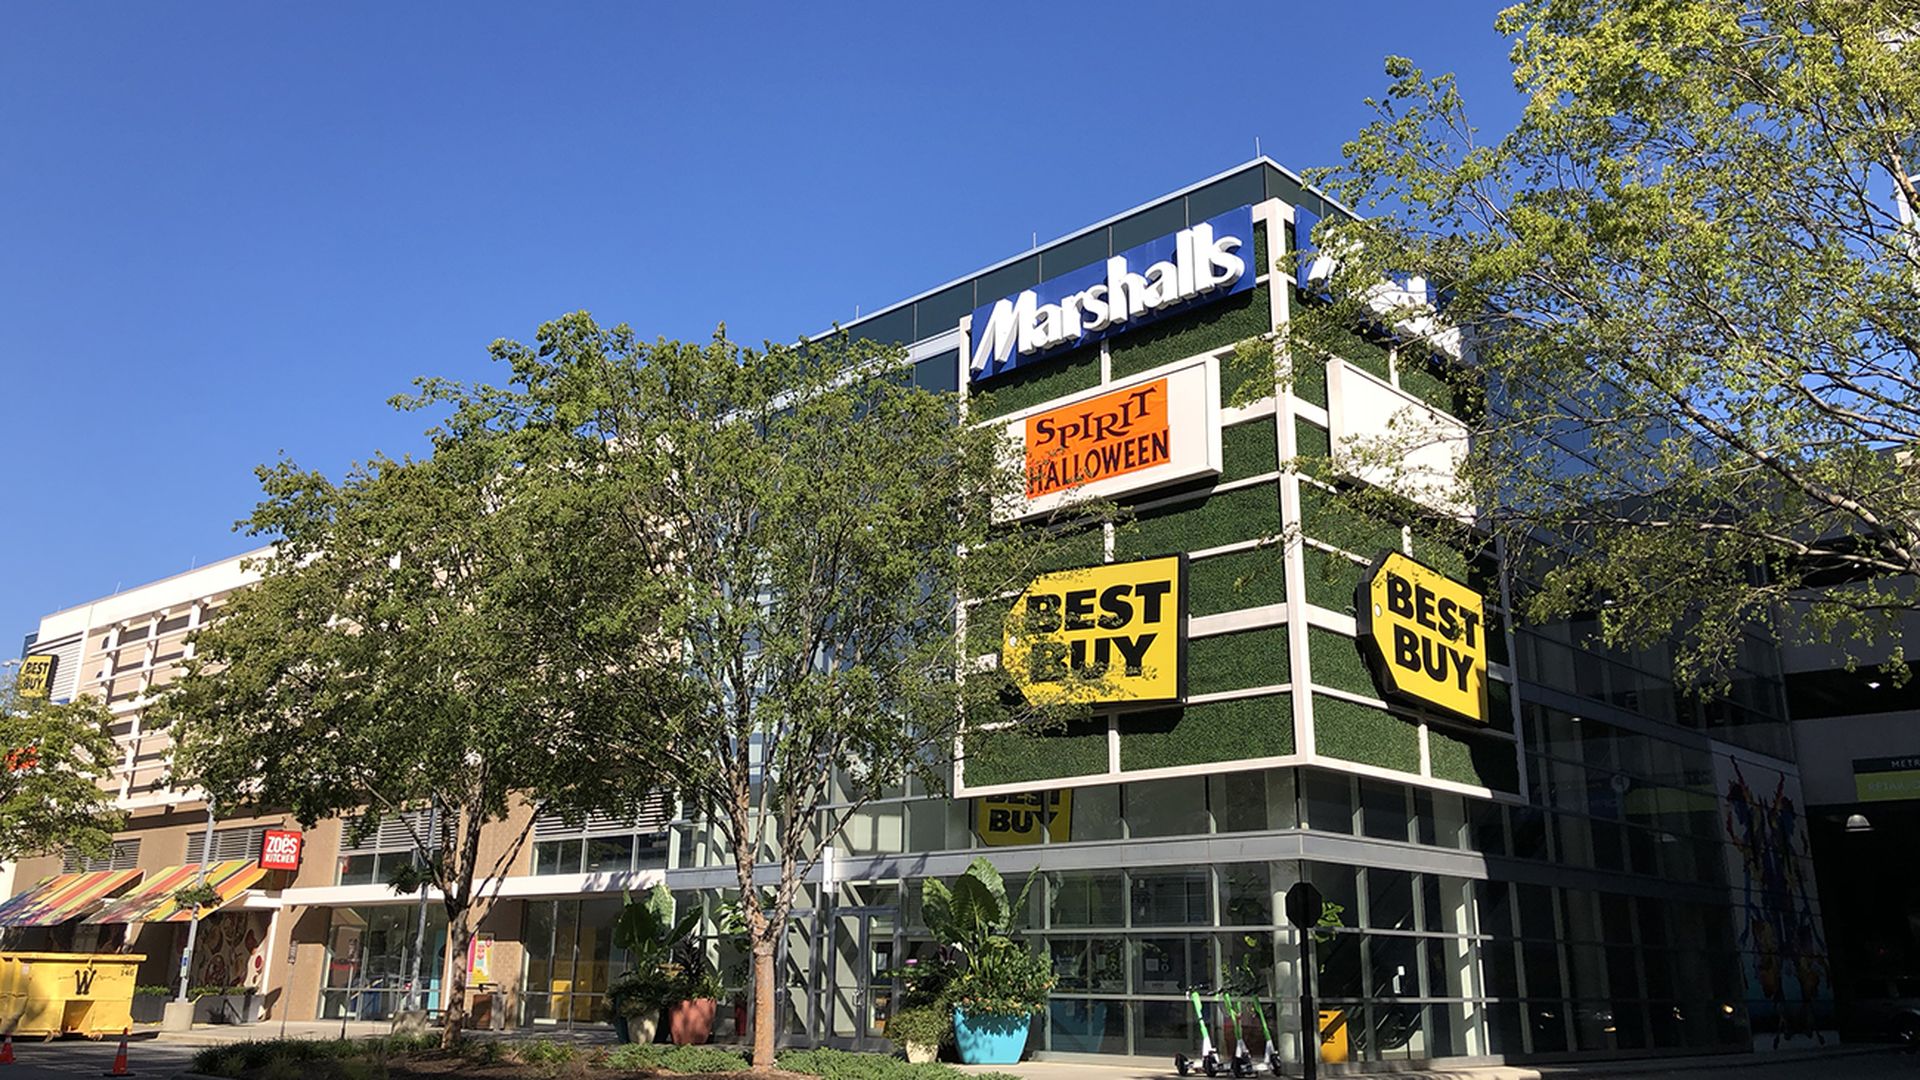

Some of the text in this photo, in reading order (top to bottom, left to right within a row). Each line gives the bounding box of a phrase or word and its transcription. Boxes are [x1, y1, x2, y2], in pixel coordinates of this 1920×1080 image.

[970, 222, 1246, 372] Marshalls
[1035, 386, 1158, 449] SPIRIT
[1028, 429, 1169, 494] HALLOWEEN
[1026, 580, 1172, 634] BEST
[1387, 570, 1480, 650] BEST
[1394, 623, 1475, 693] BUY
[75, 969, 97, 995] W
